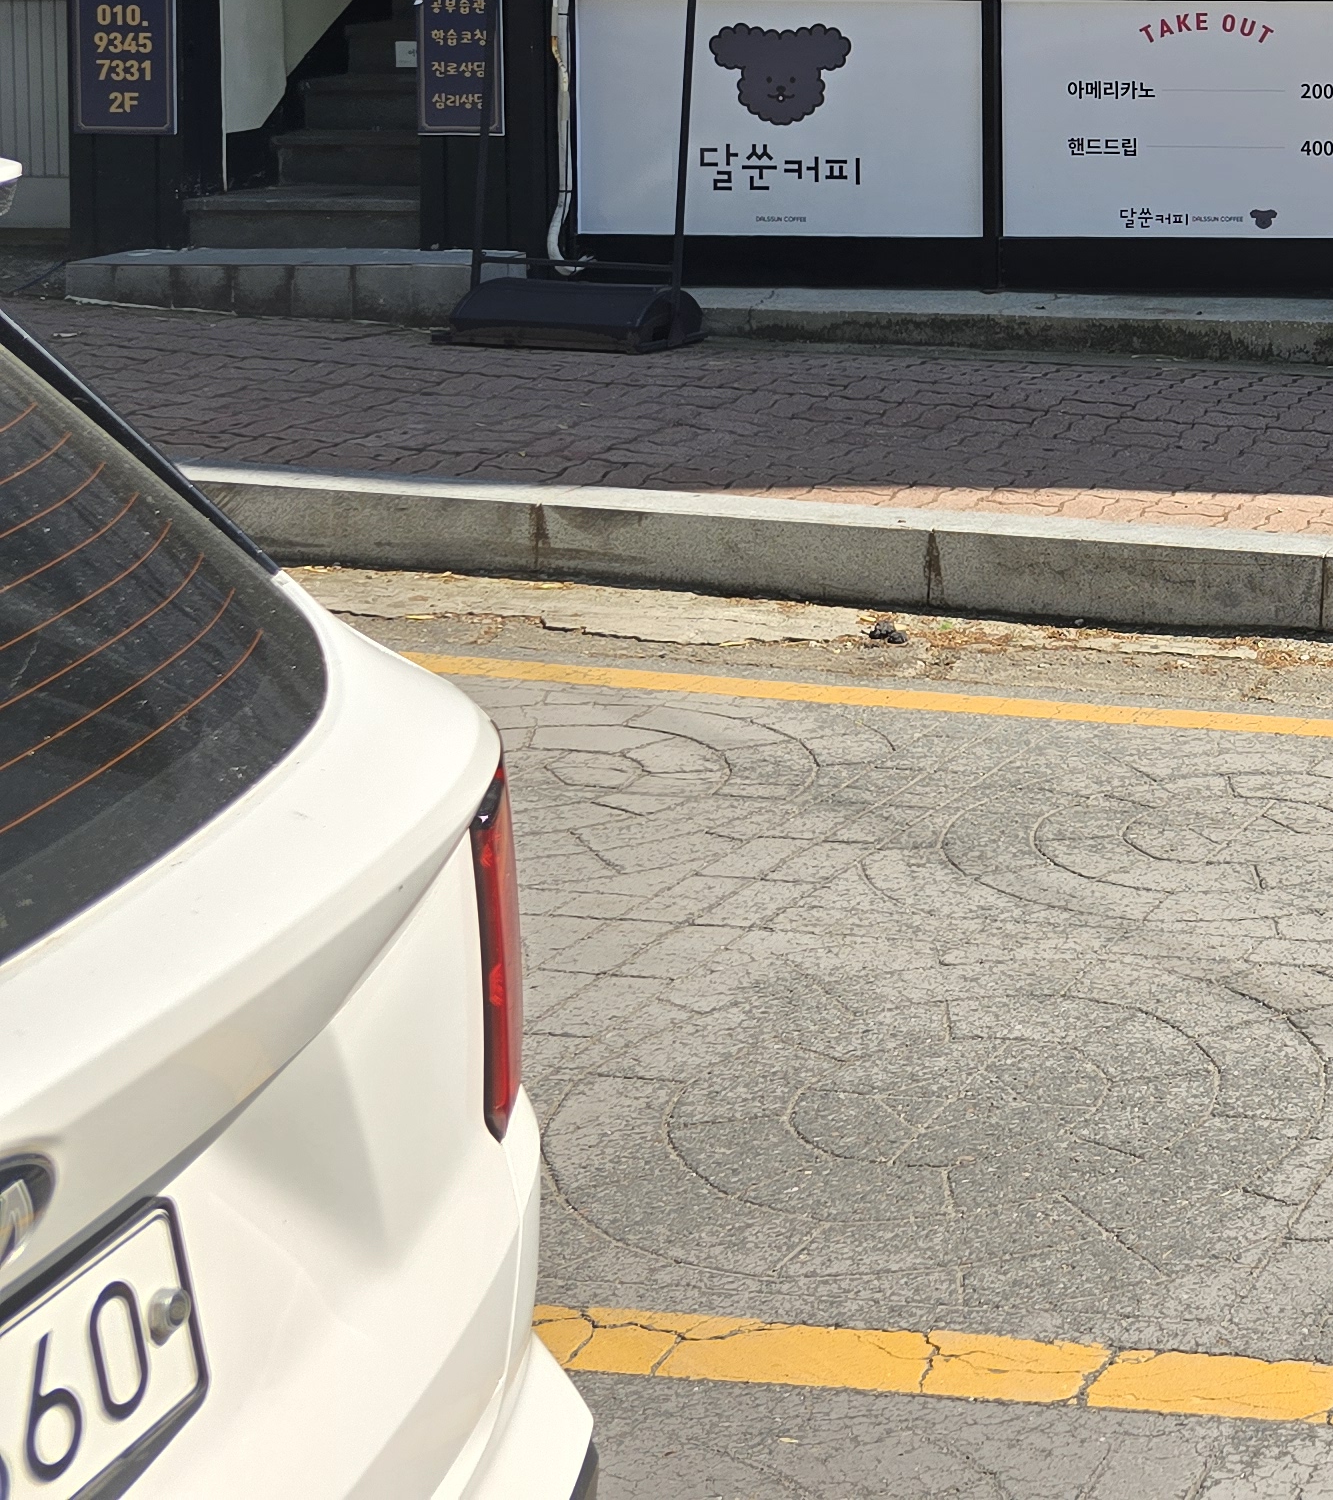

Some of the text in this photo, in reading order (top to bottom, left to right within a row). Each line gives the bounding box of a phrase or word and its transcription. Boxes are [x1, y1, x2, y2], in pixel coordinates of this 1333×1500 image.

[97, 4, 149, 27] 010.
[431, 29, 487, 46] 학습코칭
[1139, 13, 1274, 44] TAKE OUT
[94, 32, 152, 53] 9345
[96, 60, 152, 81] 7331
[1067, 80, 1156, 100] 아메리카노
[109, 92, 139, 113] 2F
[1067, 137, 1138, 157] 핸드드립
[700, 144, 861, 191] 달쑨커피
[784, 215, 807, 223] COFFEE
[1119, 208, 1189, 228] 달쑨커피
